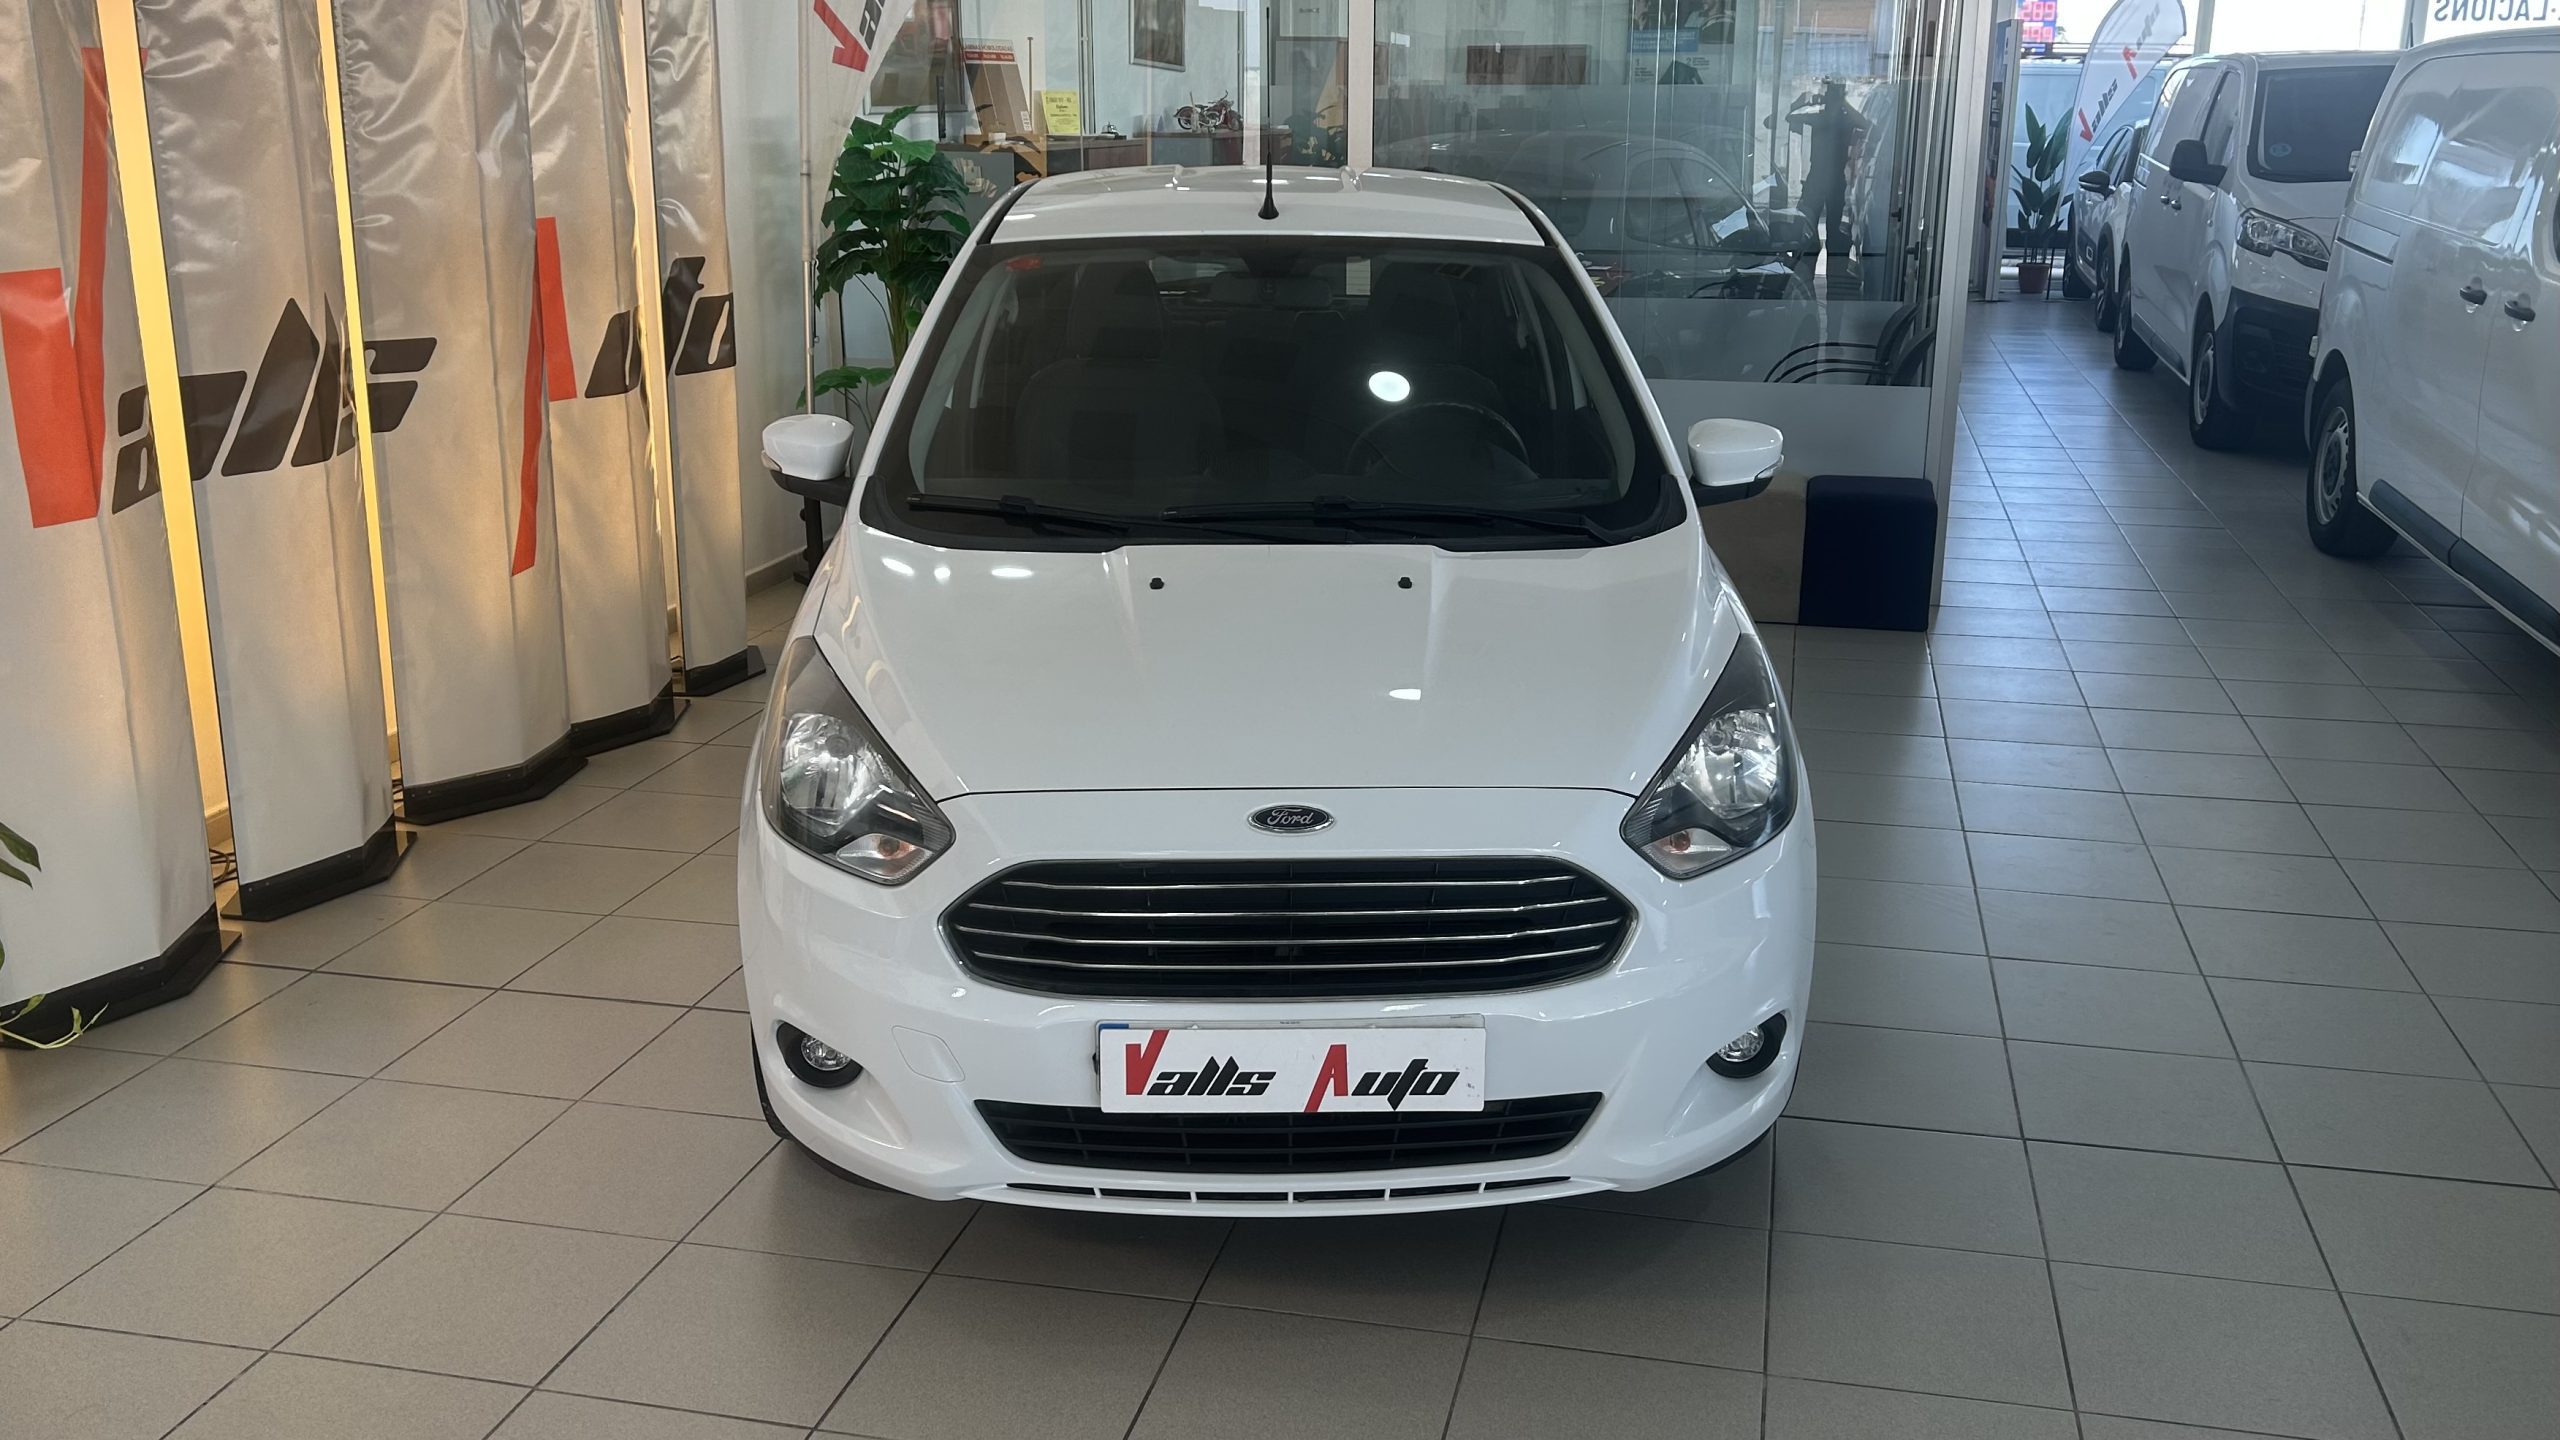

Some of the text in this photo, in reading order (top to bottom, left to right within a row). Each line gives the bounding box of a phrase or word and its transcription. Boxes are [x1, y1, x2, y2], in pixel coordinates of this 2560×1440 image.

[2077, 78, 2118, 143] Valls
[1267, 808, 1314, 825] Ford
[1125, 1029, 1460, 1113] Valls Auto
